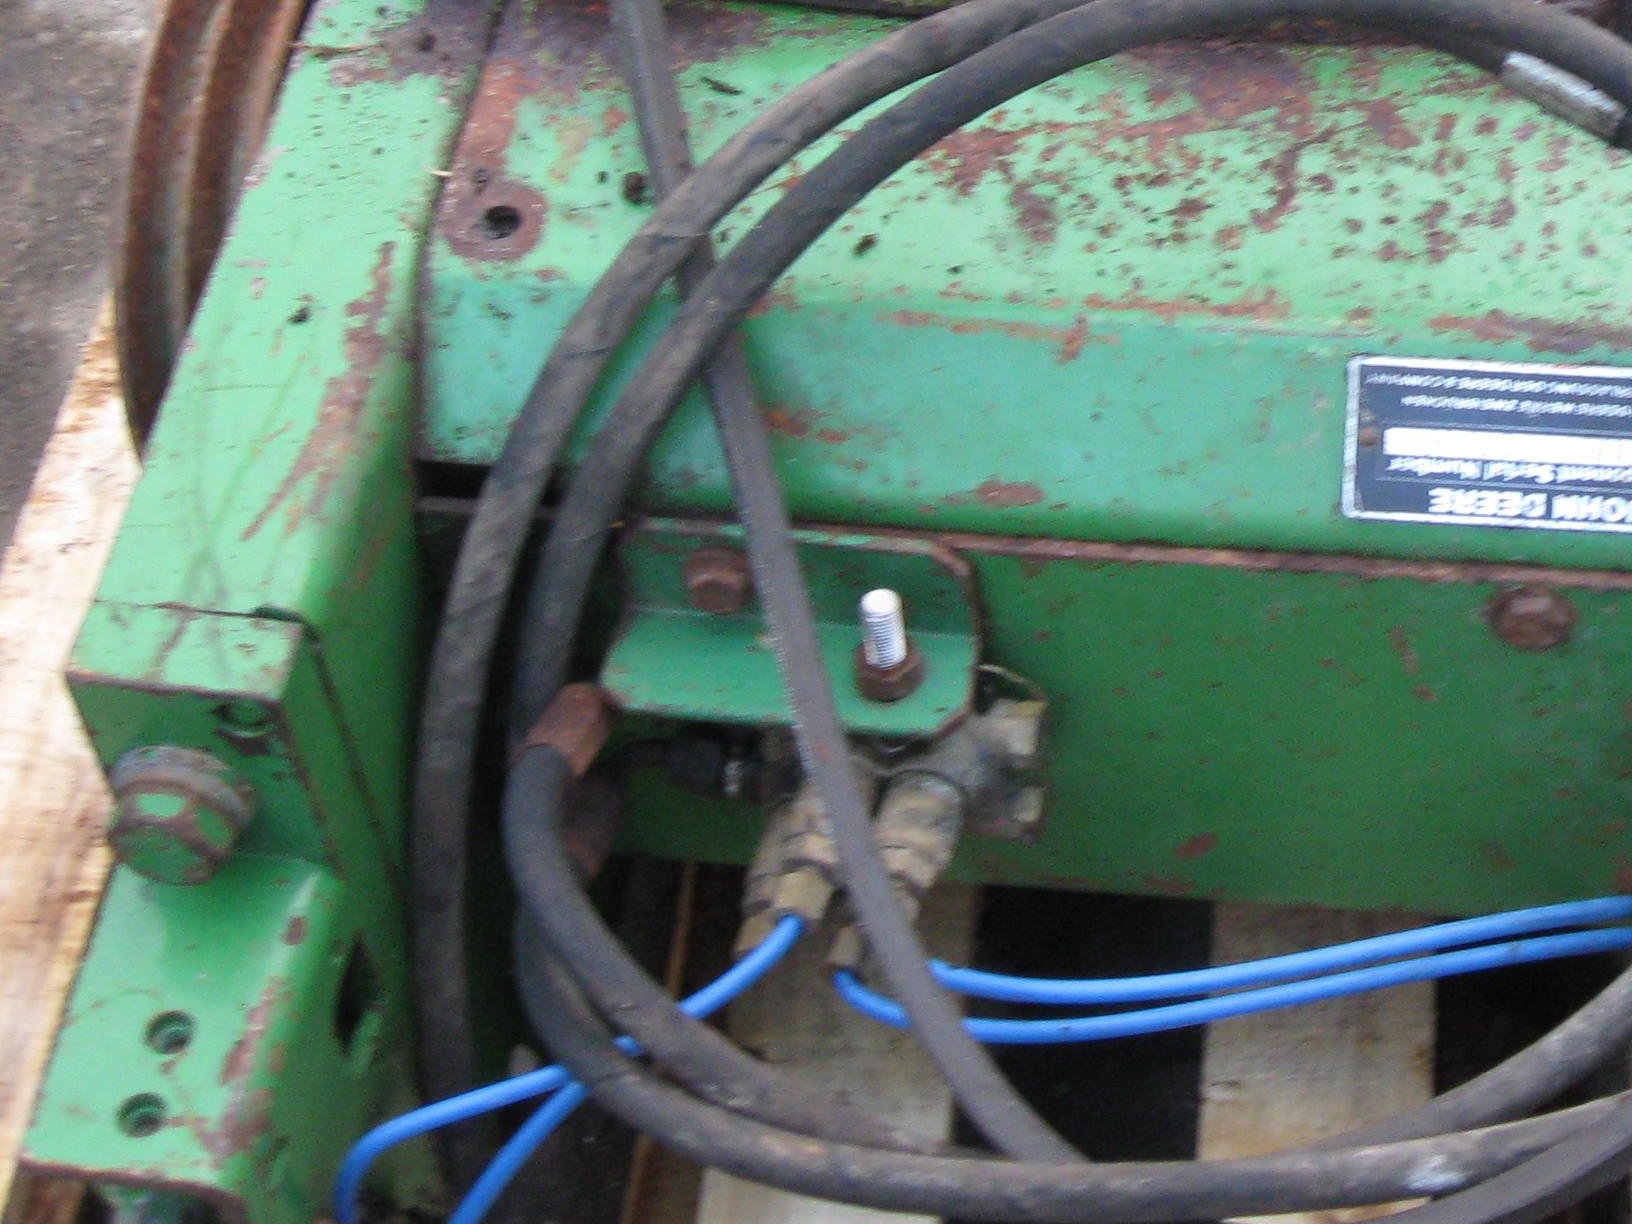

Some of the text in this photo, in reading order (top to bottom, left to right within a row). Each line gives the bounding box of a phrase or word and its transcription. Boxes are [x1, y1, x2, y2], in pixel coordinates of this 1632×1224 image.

[1386, 456, 1480, 480] Number
[1484, 460, 1557, 484] Serial
[1429, 487, 1549, 519] DEERE
